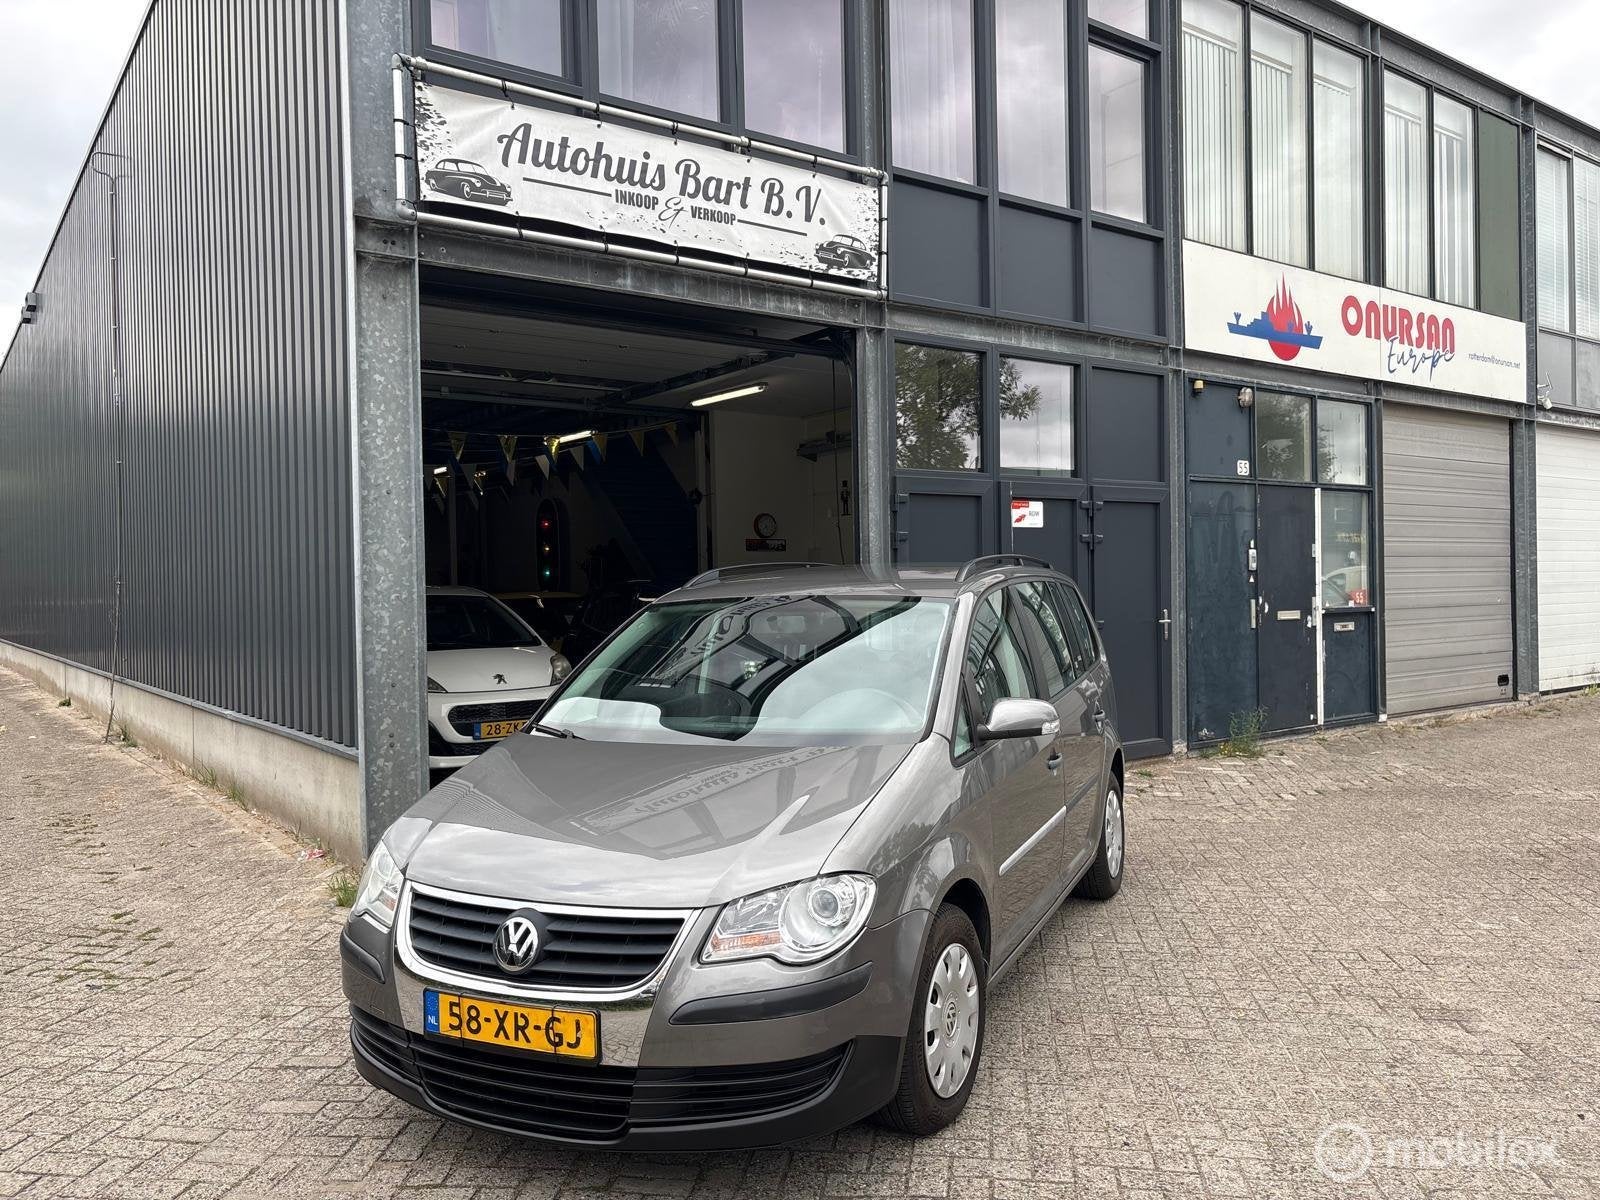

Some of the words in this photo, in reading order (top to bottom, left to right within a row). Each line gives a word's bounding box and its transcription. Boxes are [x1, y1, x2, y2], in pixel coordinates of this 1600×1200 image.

[497, 122, 667, 192] Autohuis
[674, 158, 752, 210] Bart
[760, 176, 827, 226] B.V.
[615, 188, 660, 212] INKOOP
[690, 203, 737, 226] VERKOOP
[1341, 294, 1455, 354] ONURSAN
[1386, 335, 1455, 381] Europe
[1238, 461, 1248, 474] 55
[1355, 591, 1364, 604] 55
[427, 1013, 439, 1027] NL
[448, 1000, 583, 1050] 58-XR-GJ
